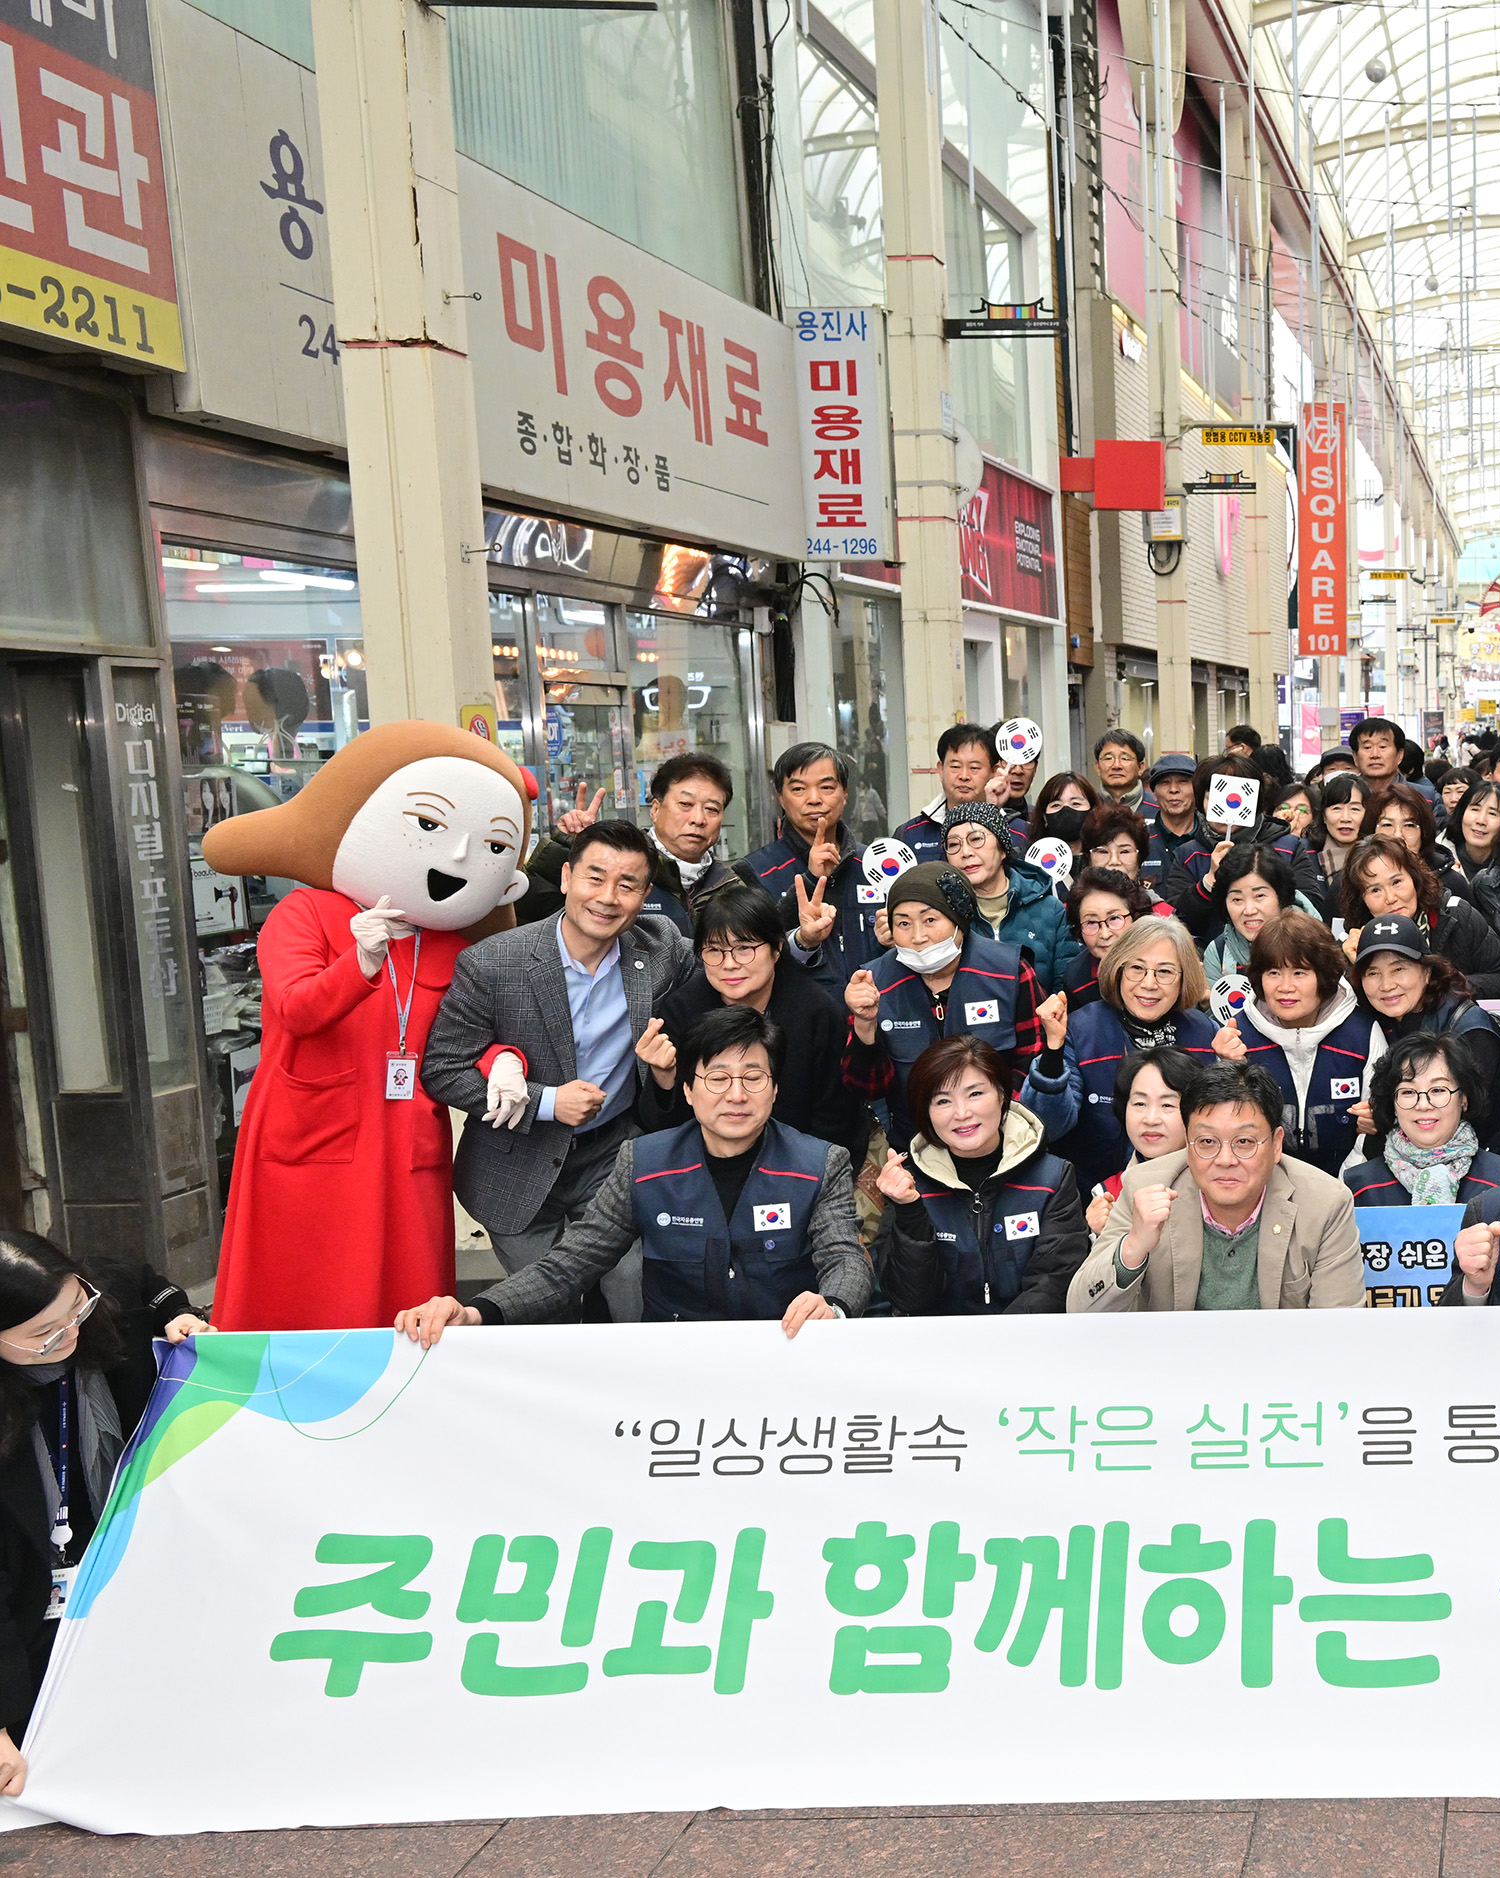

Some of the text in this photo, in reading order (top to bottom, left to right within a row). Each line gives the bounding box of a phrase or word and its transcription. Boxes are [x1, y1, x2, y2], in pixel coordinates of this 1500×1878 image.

[0, 275, 155, 354] -2211
[796, 310, 867, 342] 용진사
[496, 231, 770, 447] 미용재료
[808, 359, 868, 529] 미용재료
[1205, 431, 1226, 443] 방범용
[1229, 431, 1247, 443] CCTV
[806, 537, 877, 555] 244-1296
[1014, 520, 1041, 542] EXPLODING
[1310, 465, 1336, 625] SQUARE
[1307, 634, 1340, 651] 101
[114, 702, 156, 726] Digital
[1400, 1241, 1445, 1268] 쉬운
[615, 1415, 968, 1478] “일상생활속
[998, 1405, 1158, 1472] ‘작은
[1187, 1402, 1417, 1470] 실천’을
[269, 1526, 775, 1698] 주민과
[822, 1517, 1453, 1696] 함께하는
